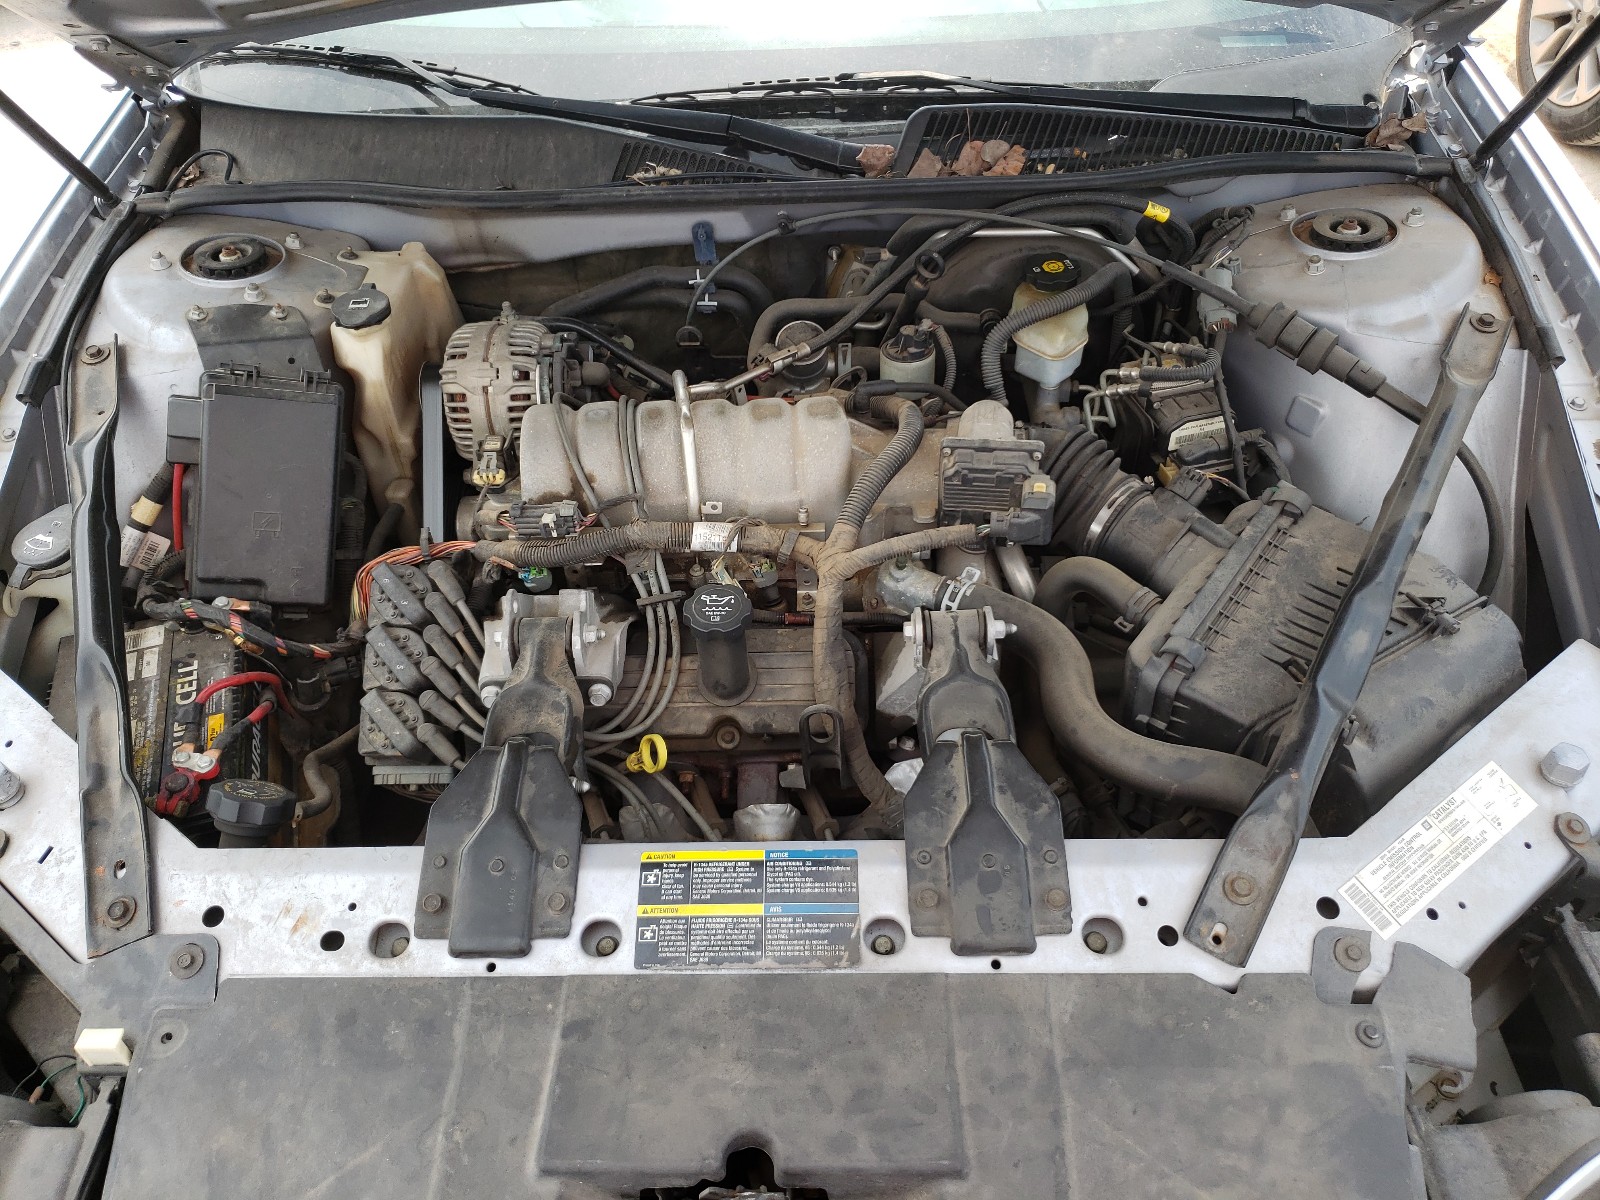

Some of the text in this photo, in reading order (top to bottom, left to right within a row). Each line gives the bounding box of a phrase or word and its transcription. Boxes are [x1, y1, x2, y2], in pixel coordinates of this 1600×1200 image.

[1430, 796, 1457, 820] CATALYST
[1370, 831, 1422, 876] VEHICLE EMISSION CONTROL
[1387, 845, 1414, 869] INFORMATION
